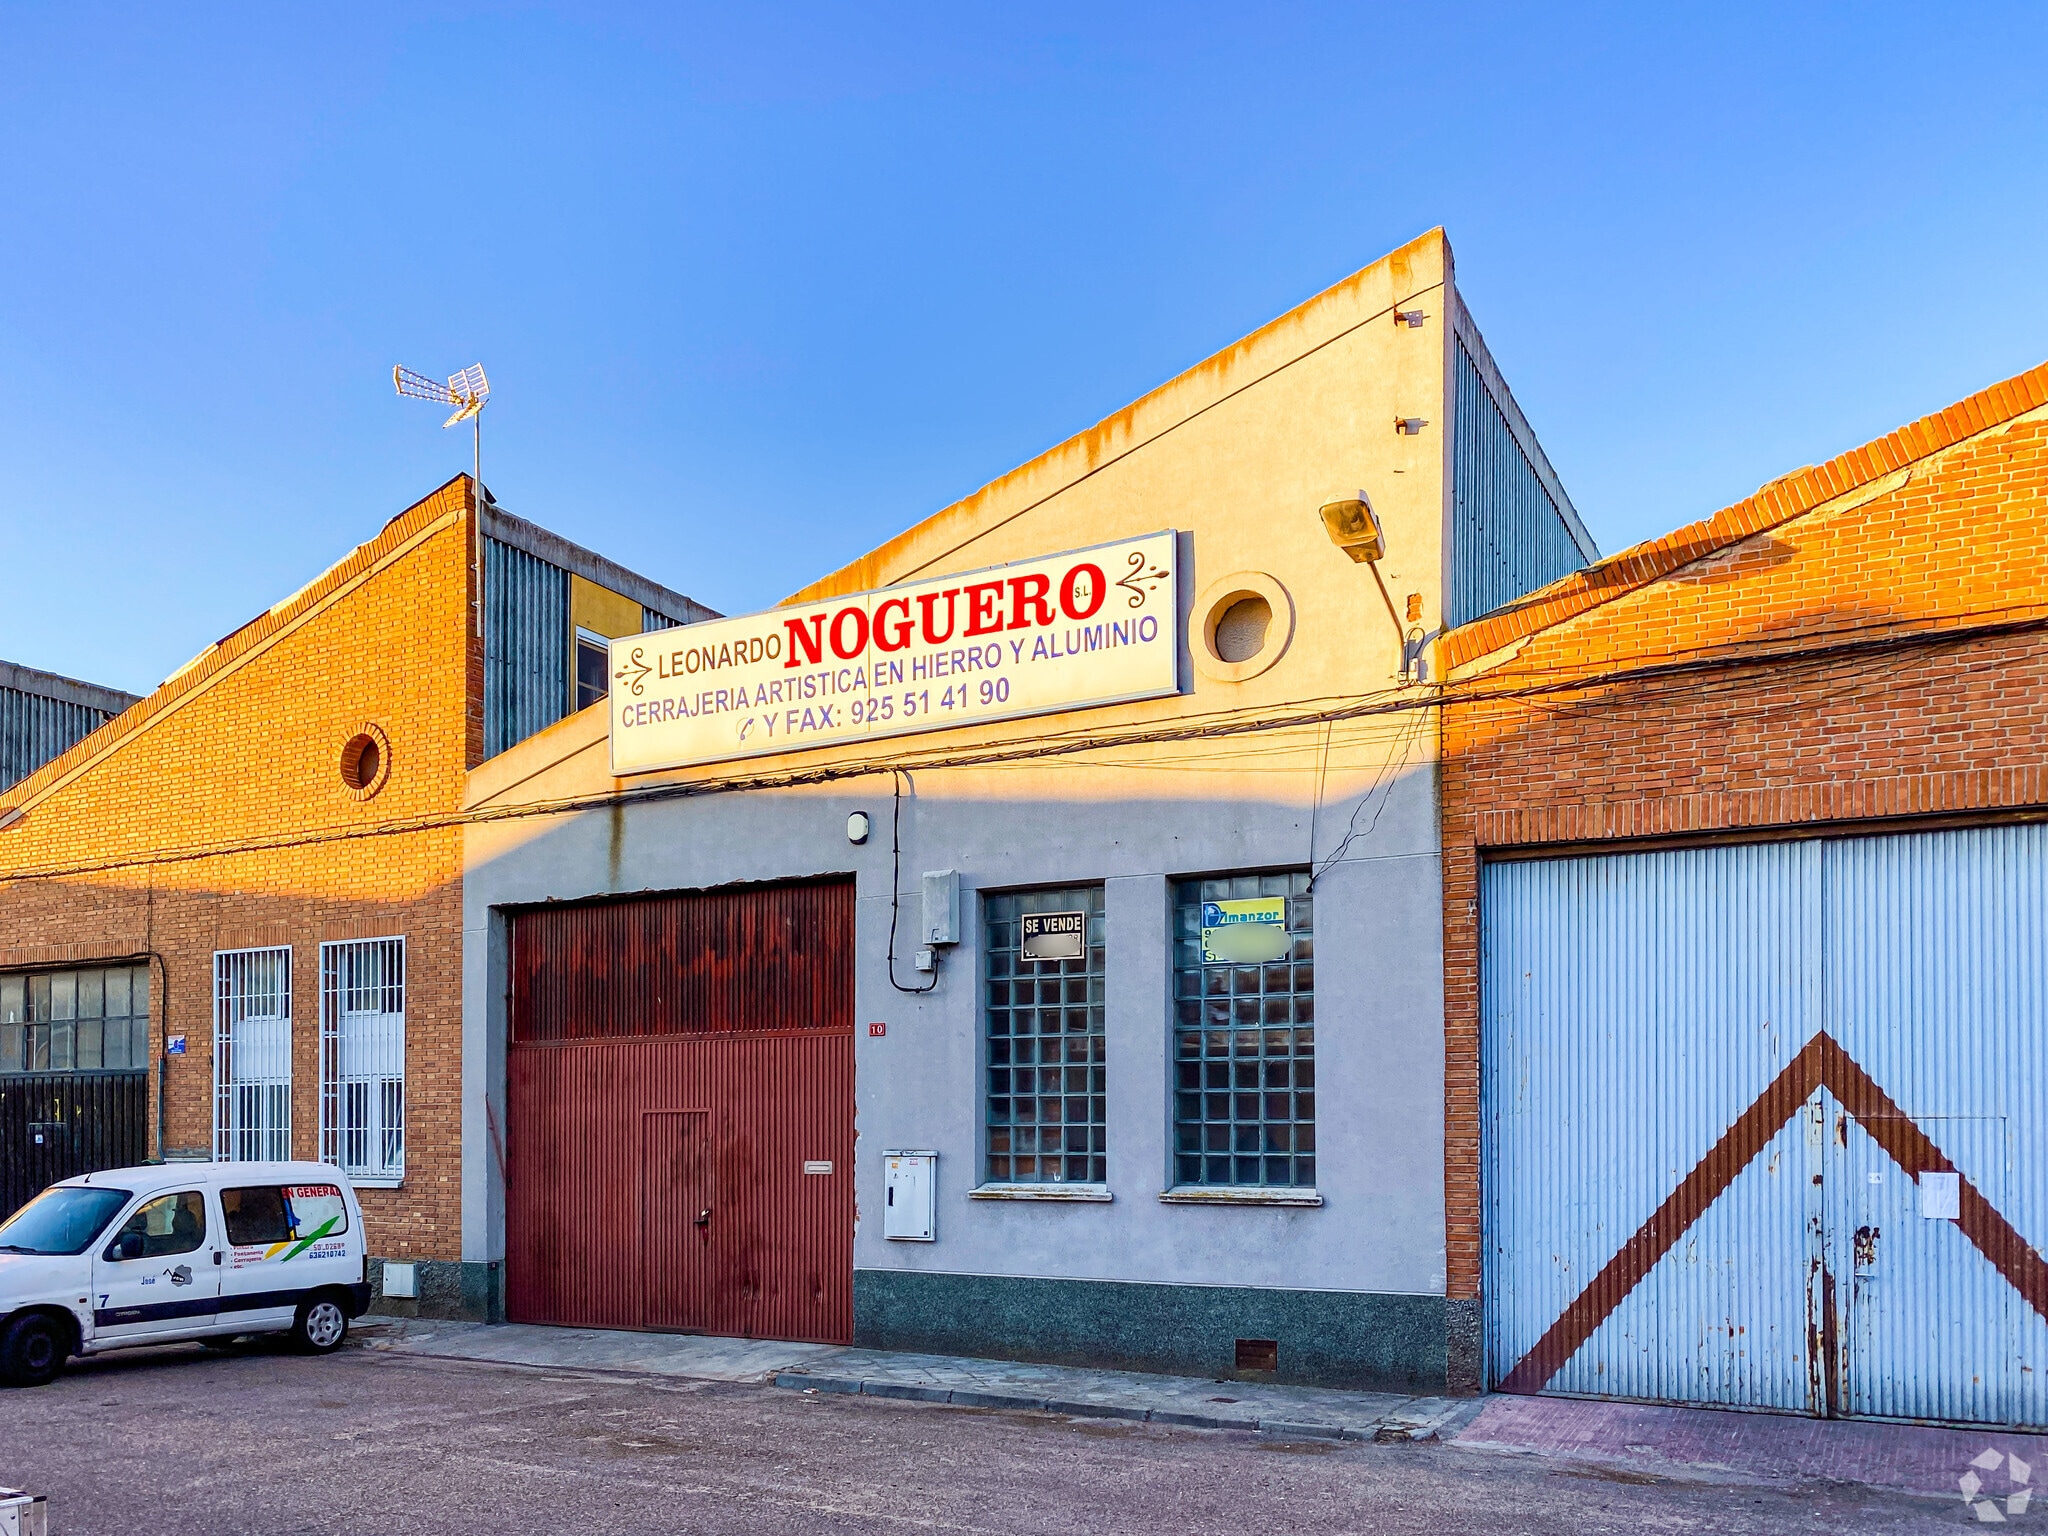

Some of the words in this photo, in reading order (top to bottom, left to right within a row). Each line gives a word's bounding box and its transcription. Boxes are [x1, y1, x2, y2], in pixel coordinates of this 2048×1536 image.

[1075, 585, 1092, 598] S.L.
[659, 634, 782, 679] LEONARDO
[784, 563, 1106, 668] NOGUERO
[622, 686, 750, 728] CERRAJERIA
[754, 666, 868, 707] ARTISTICA
[874, 659, 904, 687] EN
[912, 642, 1001, 681] HIERRO
[1009, 638, 1026, 664] Y
[1031, 615, 1158, 662] ALUMINIO
[763, 712, 778, 737] Y
[786, 703, 841, 735] FAX:
[851, 695, 894, 725] 925
[903, 689, 928, 717] 51
[940, 683, 967, 710] 41
[979, 677, 1010, 705] 90
[1025, 919, 1039, 933] SE
[1043, 916, 1081, 932] VENDE
[872, 1025, 882, 1034] 10
[99, 1294, 110, 1308] 7
